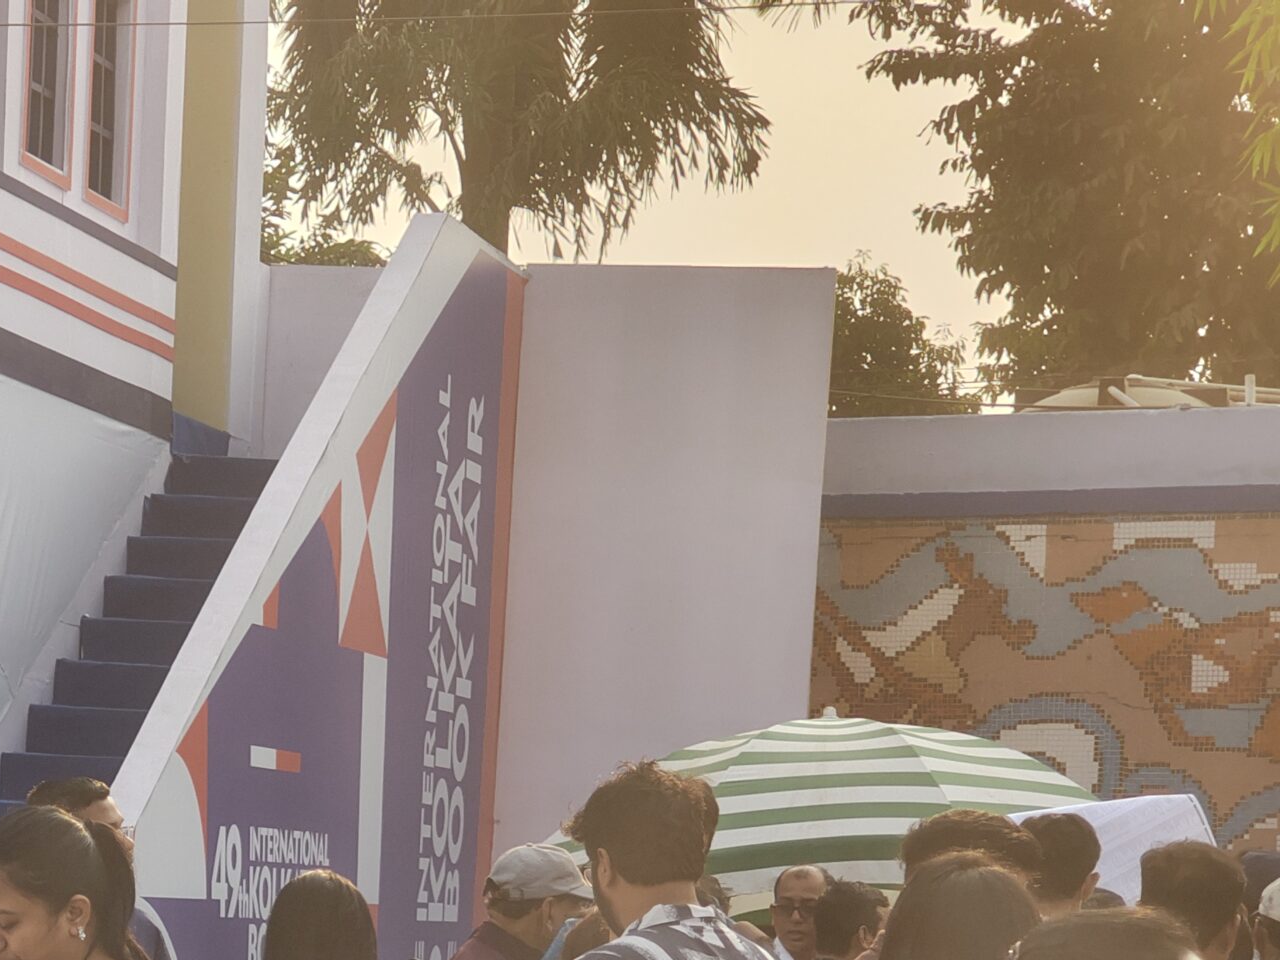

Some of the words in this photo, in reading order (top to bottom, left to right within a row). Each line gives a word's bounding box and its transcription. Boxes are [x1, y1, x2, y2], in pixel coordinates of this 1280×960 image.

[249, 825, 330, 867] INTERNATIONAL
[416, 373, 452, 922] INTERNATIONAL
[428, 457, 466, 922] KOLKATA
[443, 632, 475, 922] BOOK
[460, 395, 485, 607] FAIR
